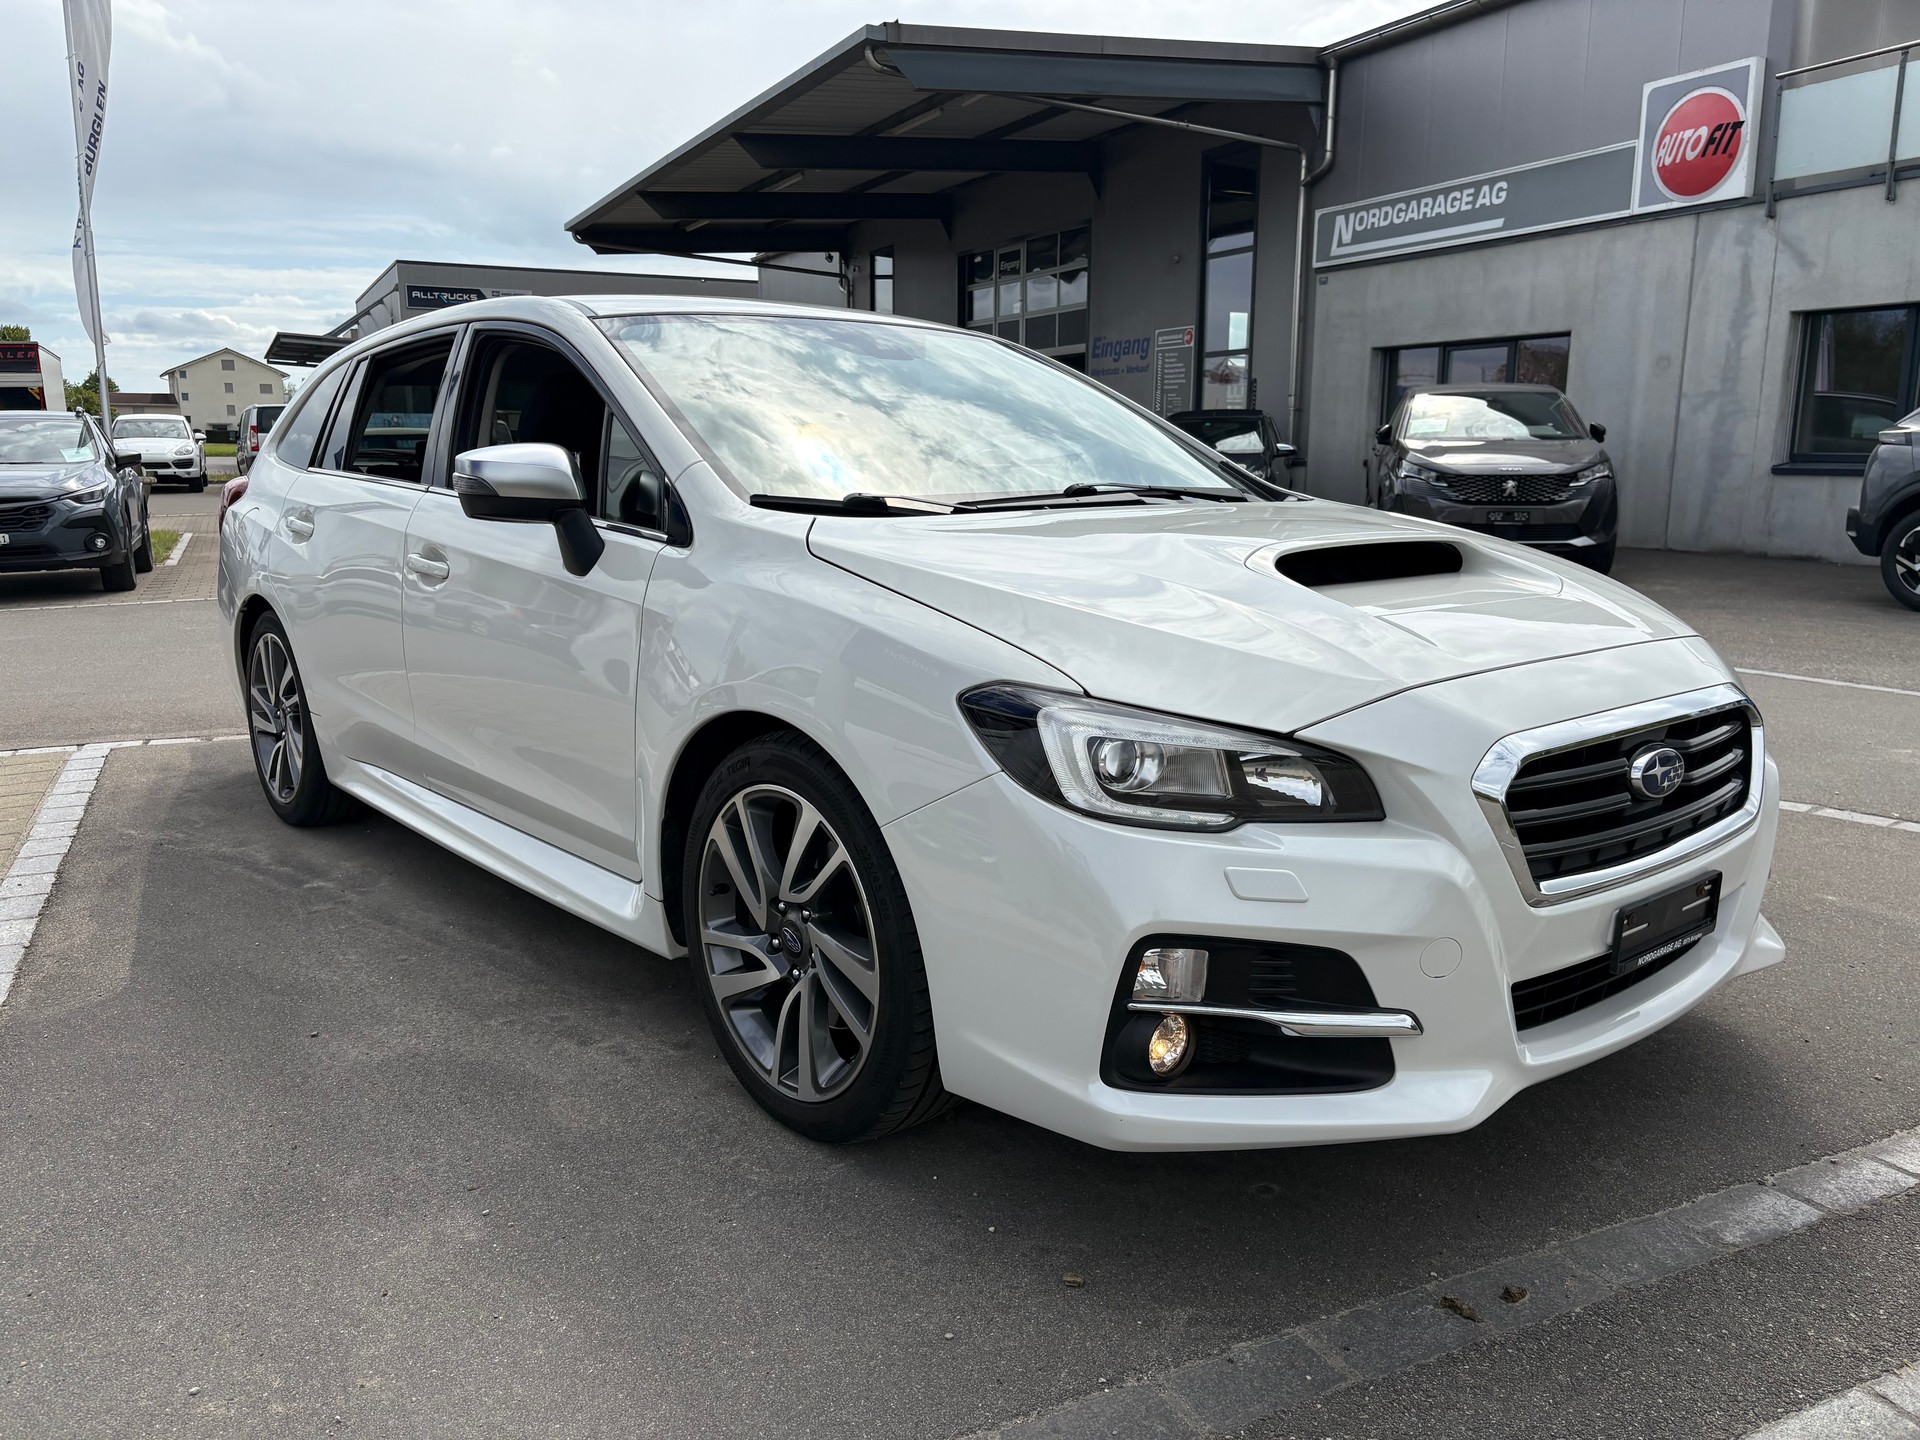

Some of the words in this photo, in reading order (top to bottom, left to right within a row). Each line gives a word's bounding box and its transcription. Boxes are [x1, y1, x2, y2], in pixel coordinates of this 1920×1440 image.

[1656, 120, 1746, 168] AUTOFIT
[1330, 188, 1476, 247] NORDGARAGE
[1475, 181, 1508, 209] AG
[412, 290, 479, 302] ALLTRUCKS
[1091, 336, 1151, 363] Eingang
[1155, 353, 1163, 412] Willkommen
[1637, 943, 1674, 966] NORDGARAGE
